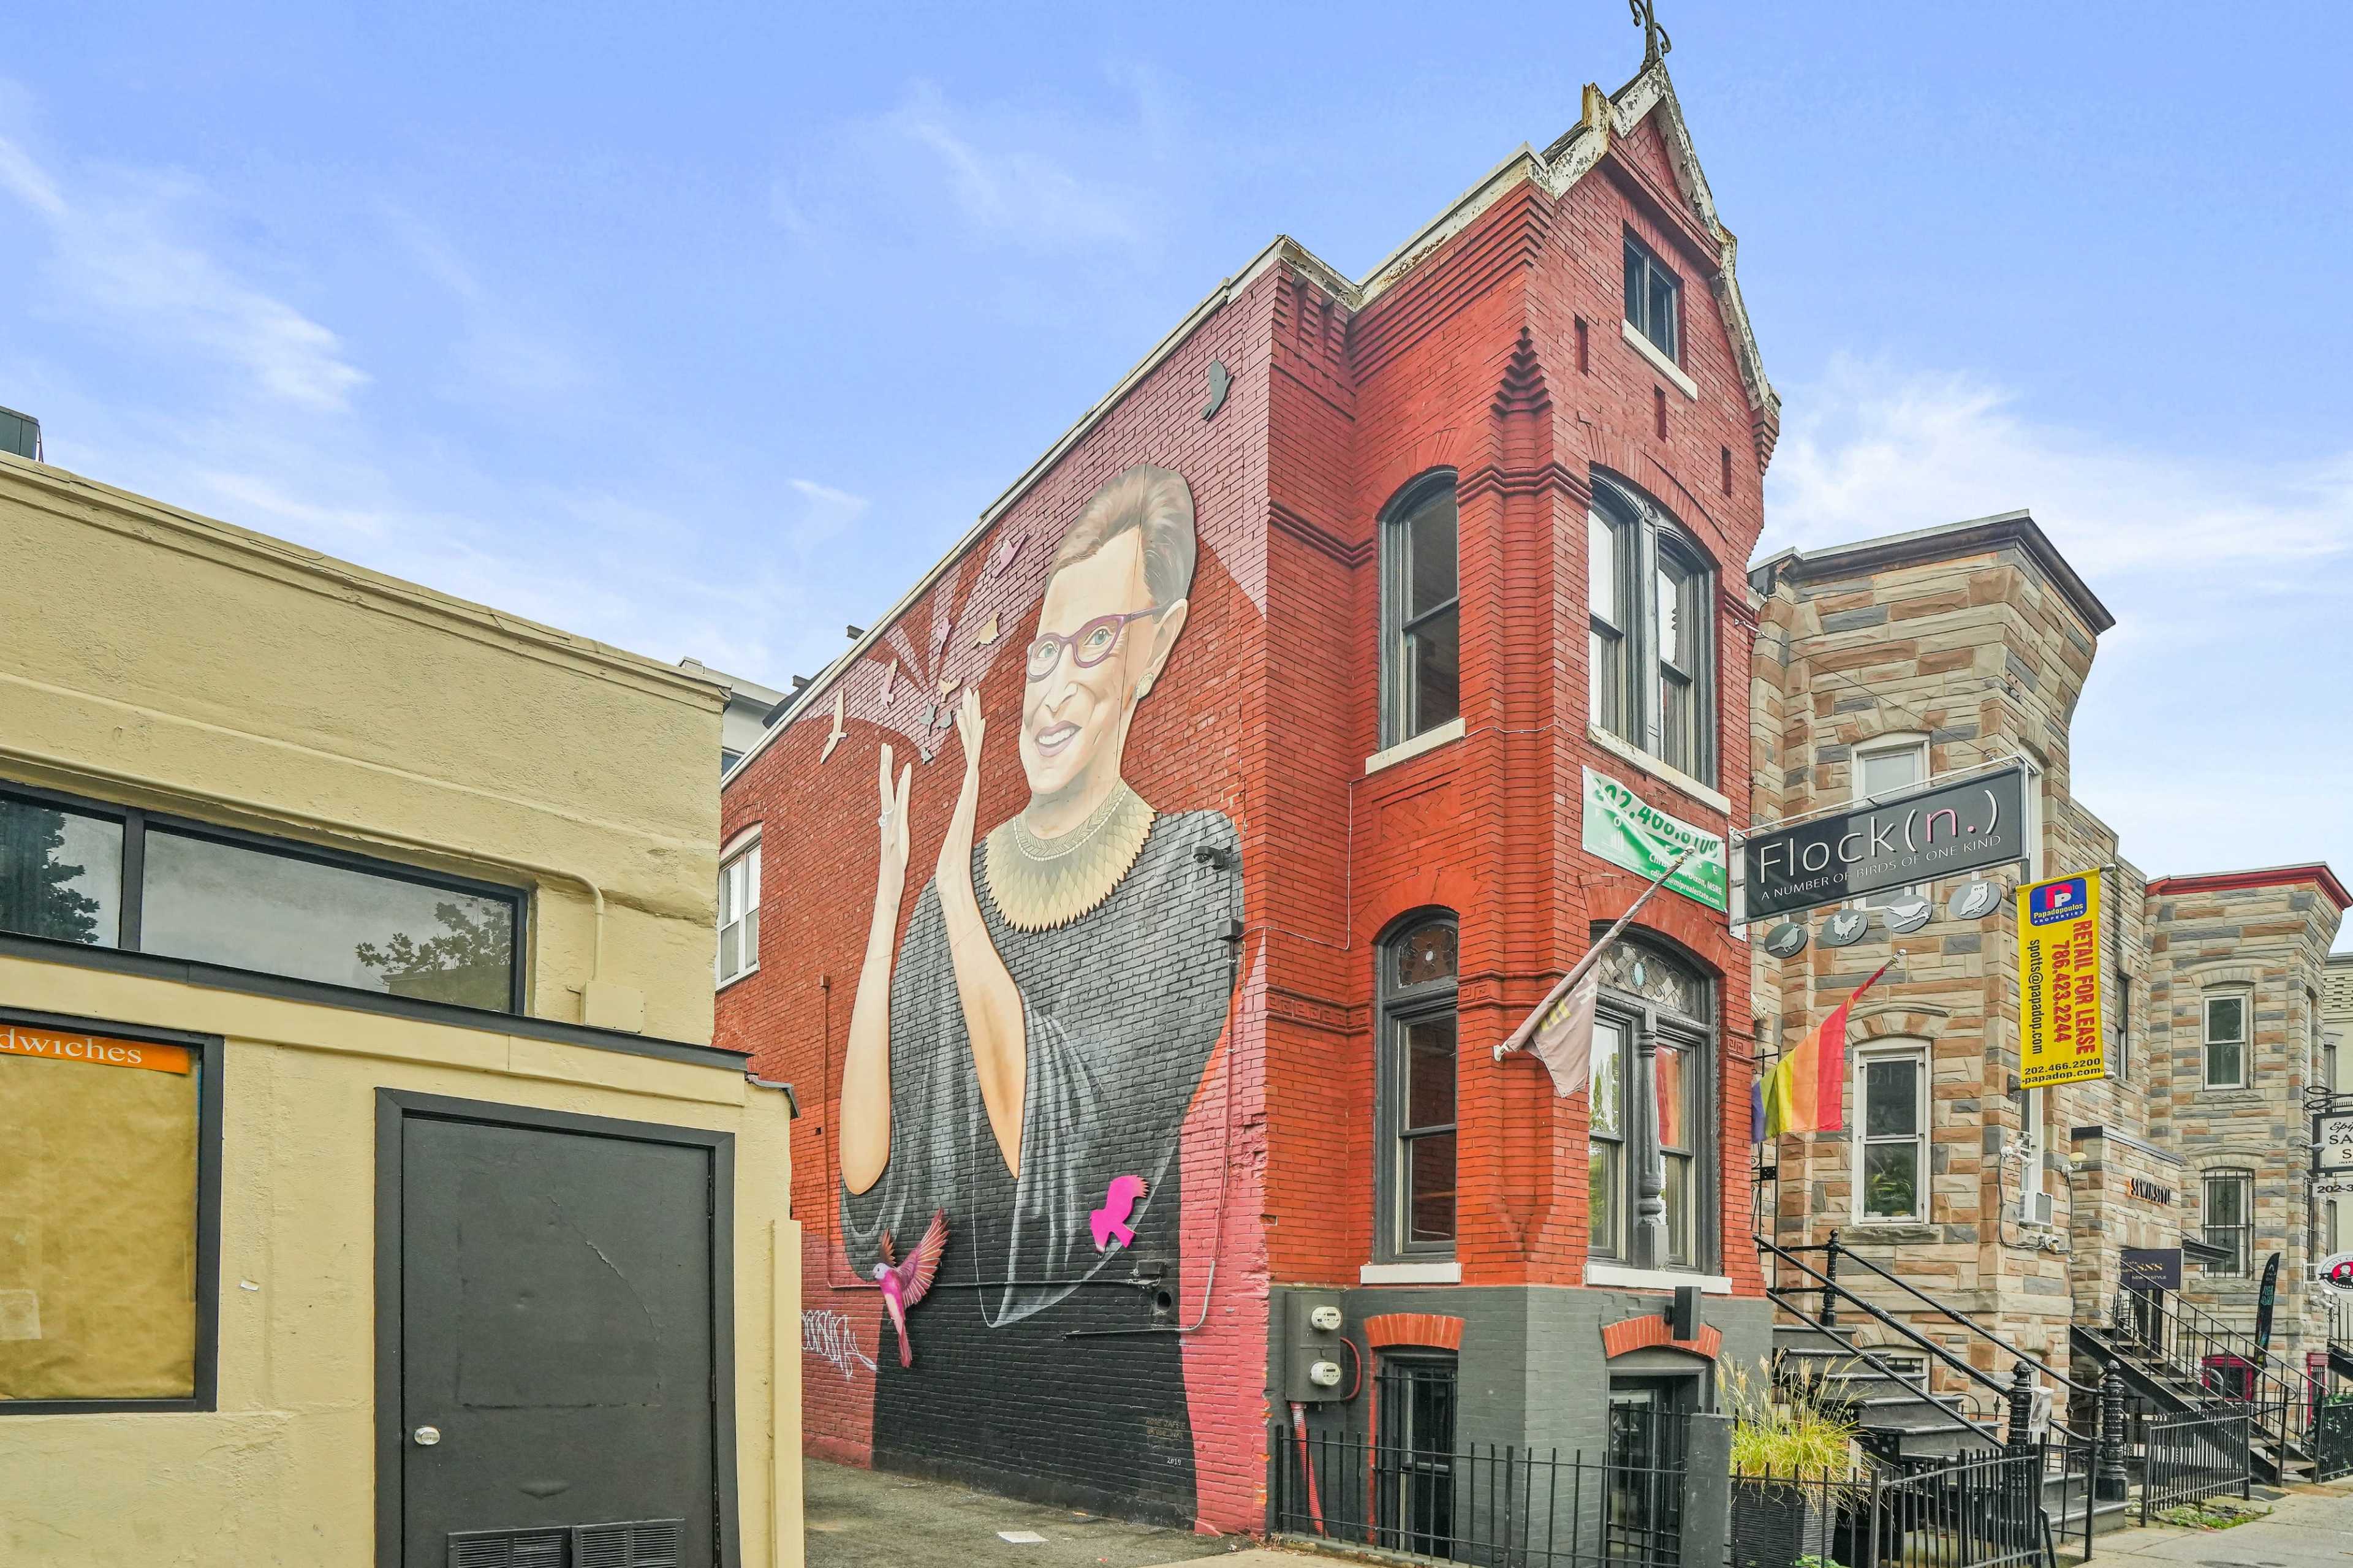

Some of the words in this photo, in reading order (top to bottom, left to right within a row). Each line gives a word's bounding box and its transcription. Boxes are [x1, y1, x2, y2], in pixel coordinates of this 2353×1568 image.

[1760, 790, 1999, 883] Flock(n.)
[1707, 881, 1722, 895] MSRE
[1761, 891, 1770, 900] A
[1774, 877, 1829, 898] NUMBER
[1857, 861, 1896, 878] BIRDS
[1901, 855, 1919, 867] OF
[1926, 845, 1957, 862] ONE
[1963, 835, 2001, 852] KIND
[2034, 903, 2083, 919] Papadopoulos
[2034, 911, 2083, 923] PROPERTIES
[2073, 920, 2093, 972] RETAIL
[2027, 939, 2044, 1055] spotts@papadop.com
[2052, 940, 2072, 1043] 786.423.2244
[2074, 974, 2095, 1006] FOR
[2075, 1009, 2096, 1056] LEASE
[2025, 1058, 2101, 1075] 202.466.2200
